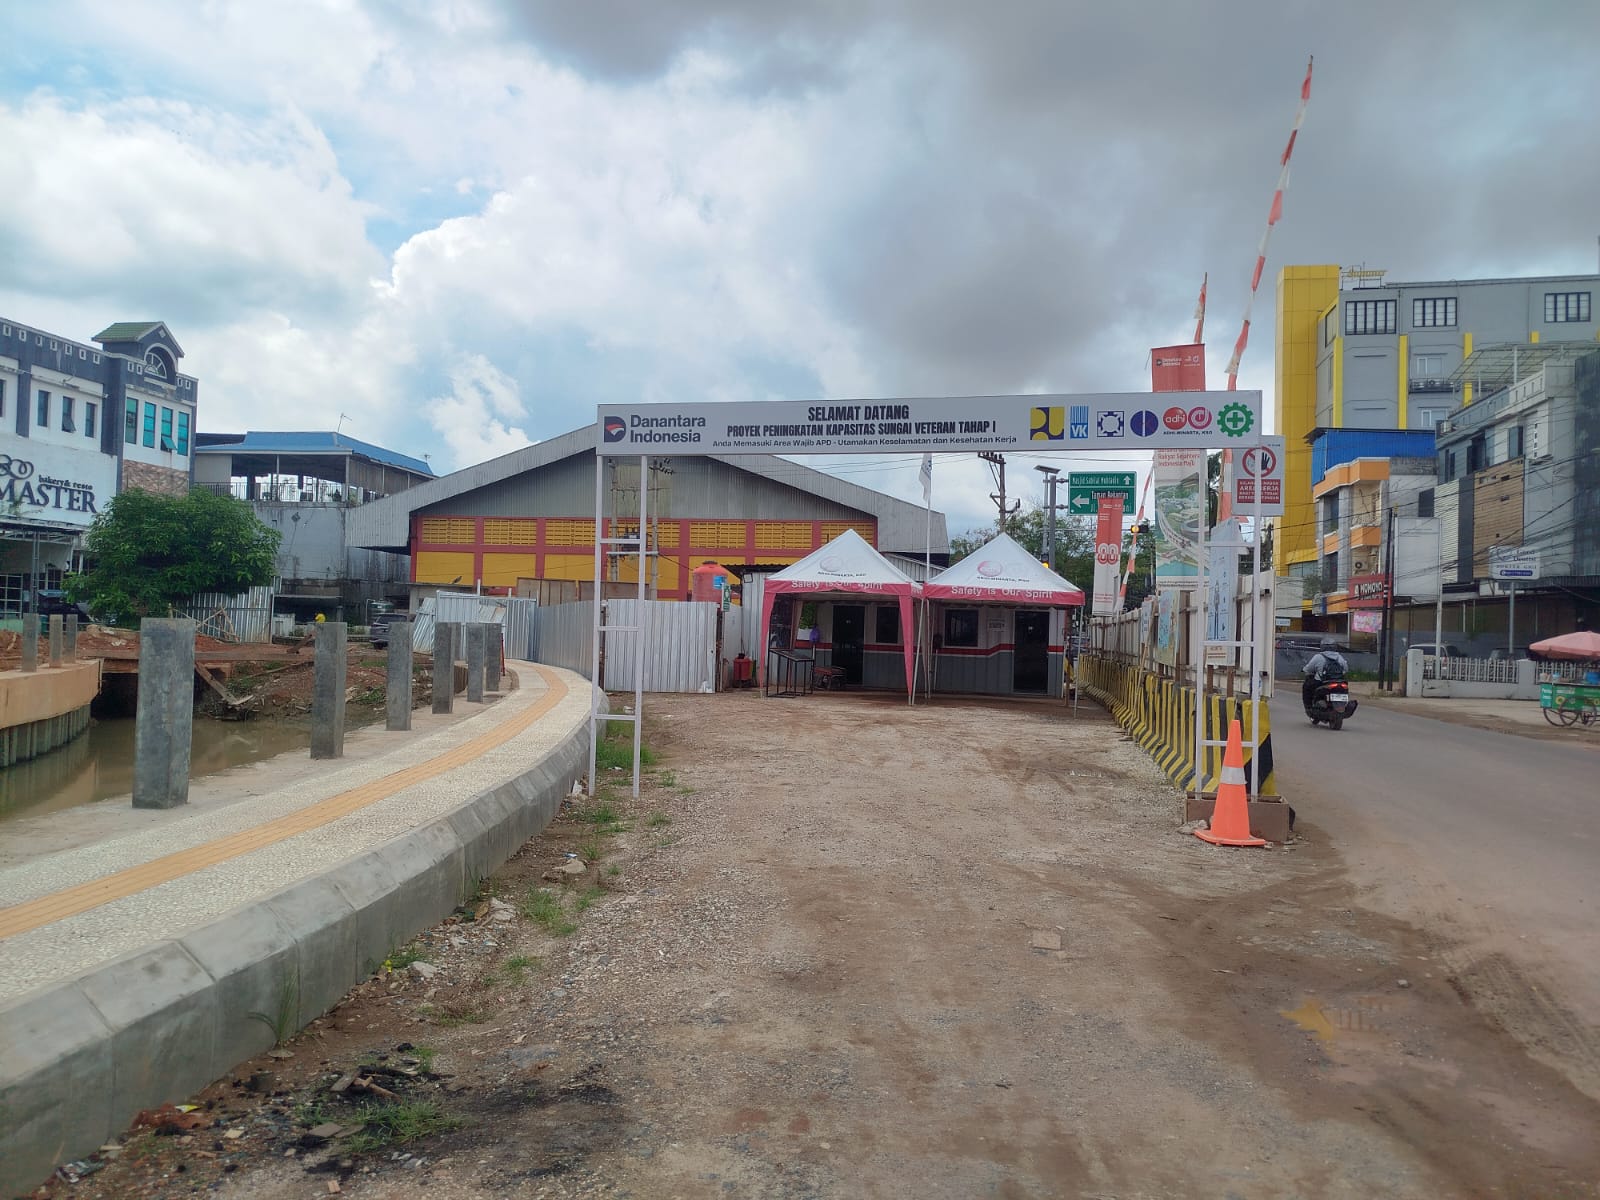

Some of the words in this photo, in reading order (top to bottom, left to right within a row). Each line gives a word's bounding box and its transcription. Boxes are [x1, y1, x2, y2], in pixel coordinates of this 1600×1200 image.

[808, 405, 861, 421] SELAMAT
[864, 404, 909, 421] DATANG
[1165, 414, 1185, 424] adhi
[630, 414, 706, 428] Danantara
[727, 425, 760, 437] PROYEK
[763, 424, 823, 437] PENINGKATAN
[826, 423, 876, 436] KAPASITAS
[878, 422, 912, 435] SUNGAI
[915, 421, 958, 434] VETERAN
[959, 421, 992, 433] TAHAP
[1071, 425, 1087, 437] VK
[630, 429, 701, 443] Indonesia
[713, 440, 732, 448] Anda
[734, 440, 772, 448] Memasuki
[793, 439, 815, 448] Wajib
[838, 438, 878, 446] Utamakan
[879, 437, 931, 446] Keselamatan
[933, 437, 948, 445] dan
[949, 436, 993, 444] Kesehatan
[995, 436, 1017, 445] Kerja
[72, 481, 93, 491] resto
[791, 580, 820, 589] Safety
[951, 586, 982, 597] Safety
[1002, 588, 1021, 596] Our
[1025, 590, 1053, 600] Spirit
